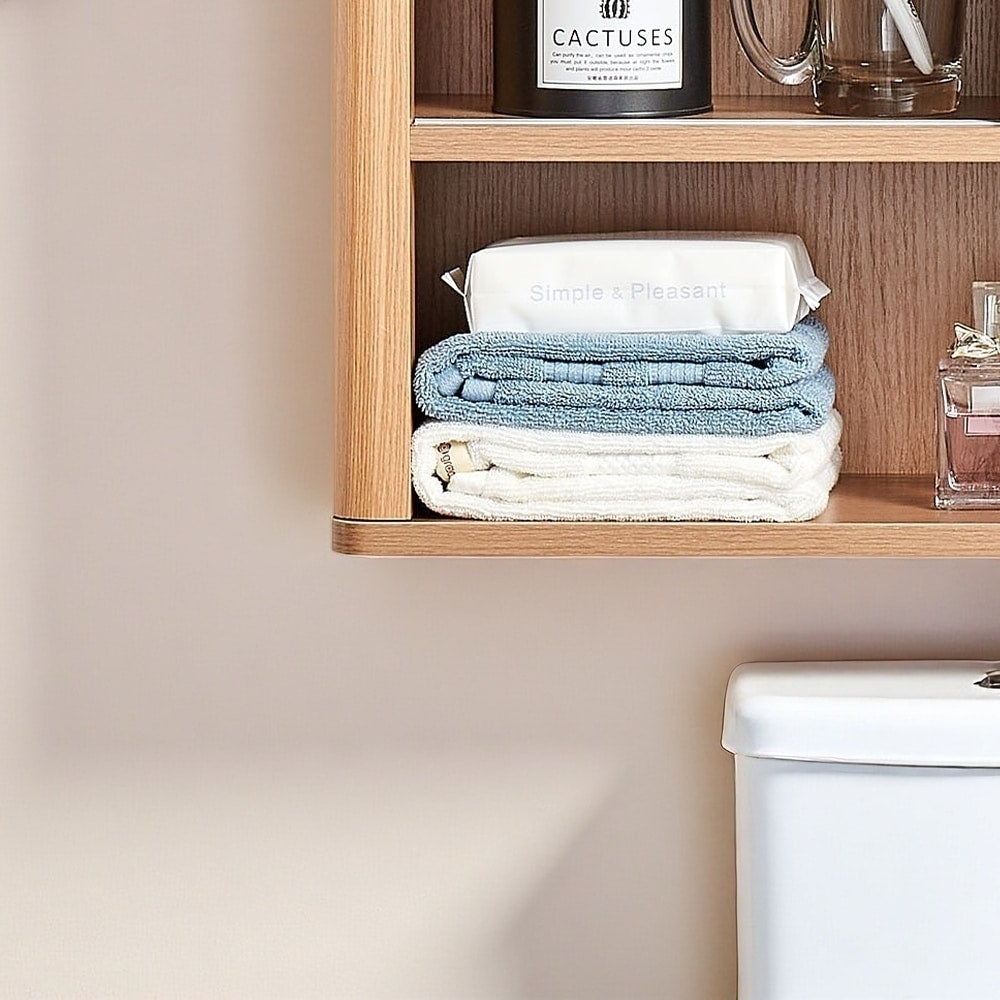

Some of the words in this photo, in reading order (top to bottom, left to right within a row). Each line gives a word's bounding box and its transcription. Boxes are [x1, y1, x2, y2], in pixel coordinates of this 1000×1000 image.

[552, 28, 673, 47] CACTUSES
[529, 284, 604, 303] Simple
[611, 286, 624, 300] &
[631, 282, 727, 300] Pleasant
